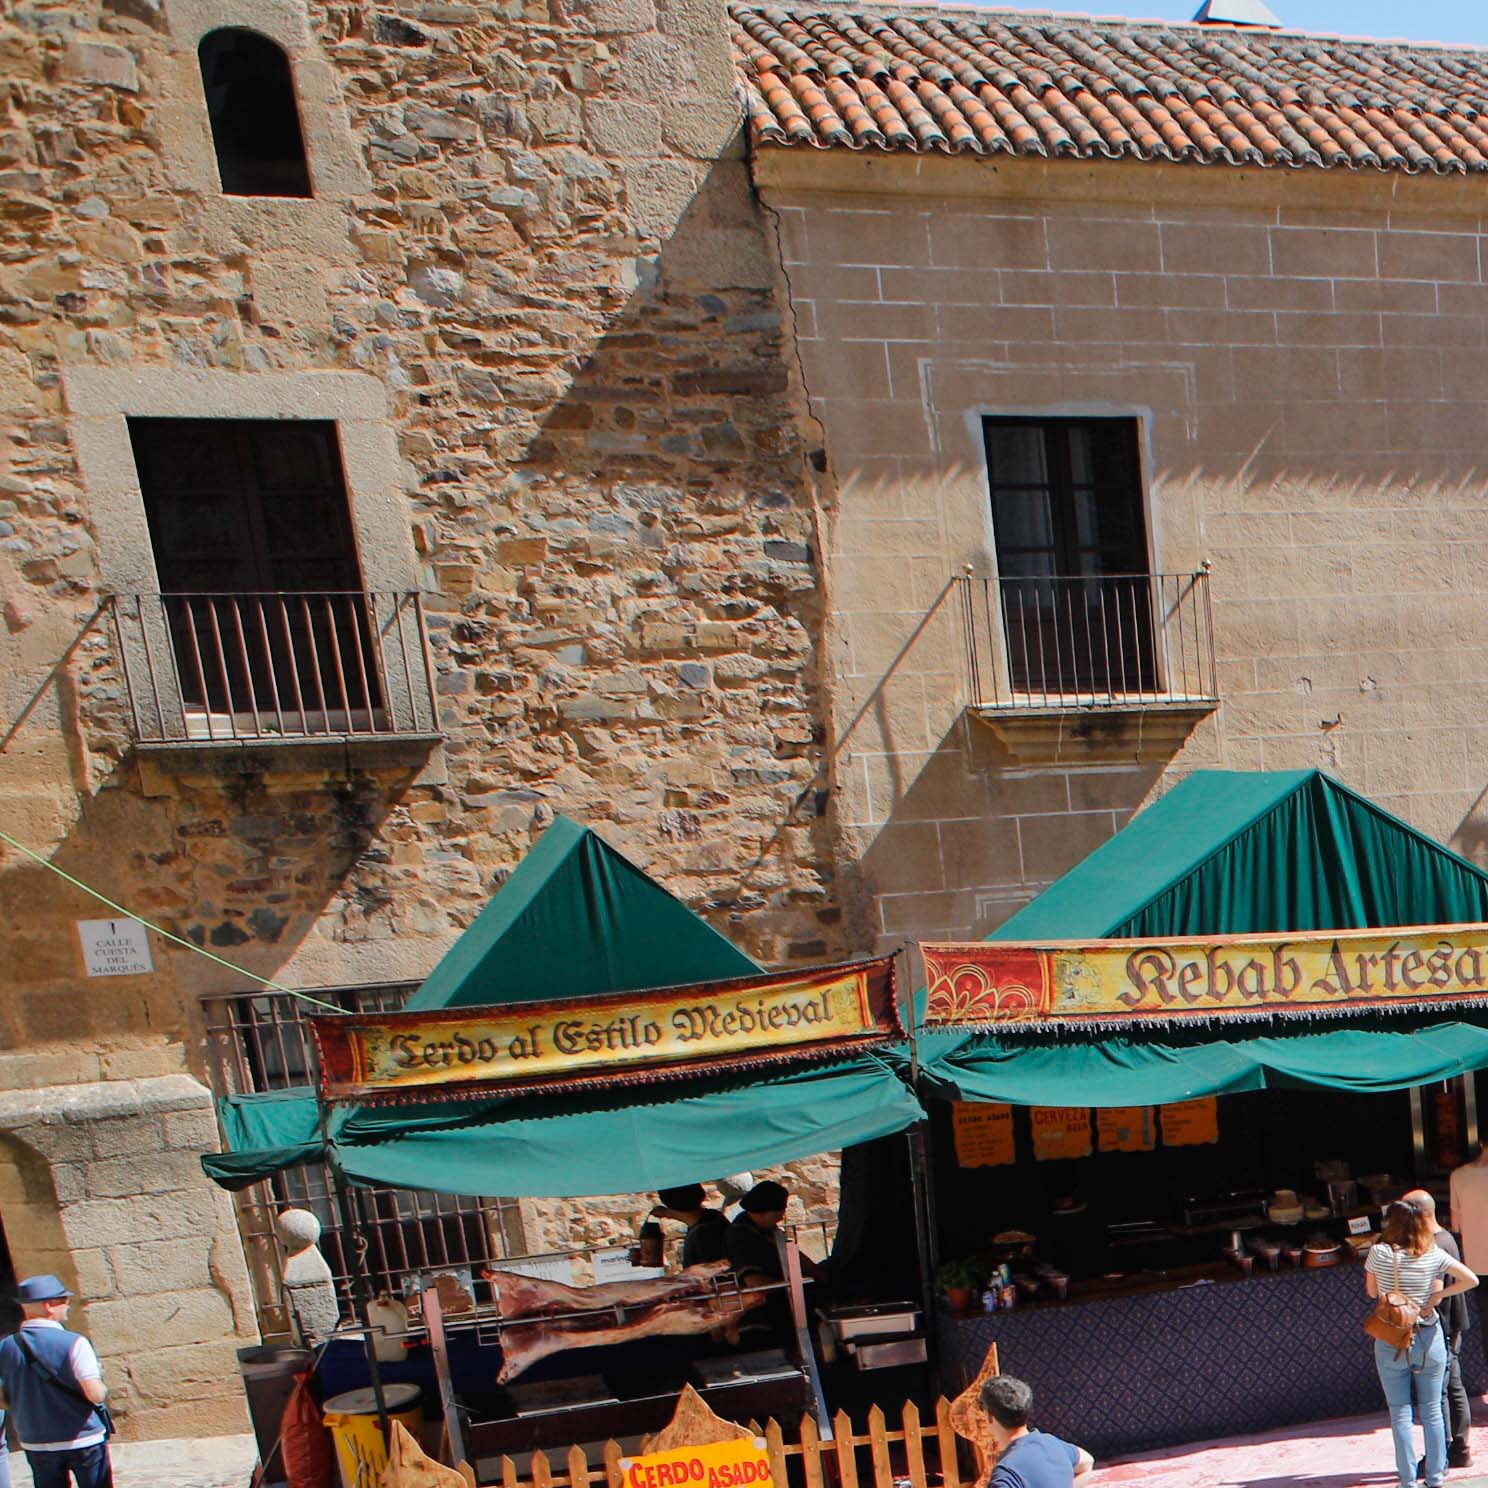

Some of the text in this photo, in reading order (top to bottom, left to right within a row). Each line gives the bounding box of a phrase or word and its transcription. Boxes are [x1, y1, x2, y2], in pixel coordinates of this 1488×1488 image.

[1116, 943, 1301, 1007] Kebab
[389, 988, 834, 1069] Cerdo al Estilo Medieval
[708, 1459, 769, 1488] ASADO
